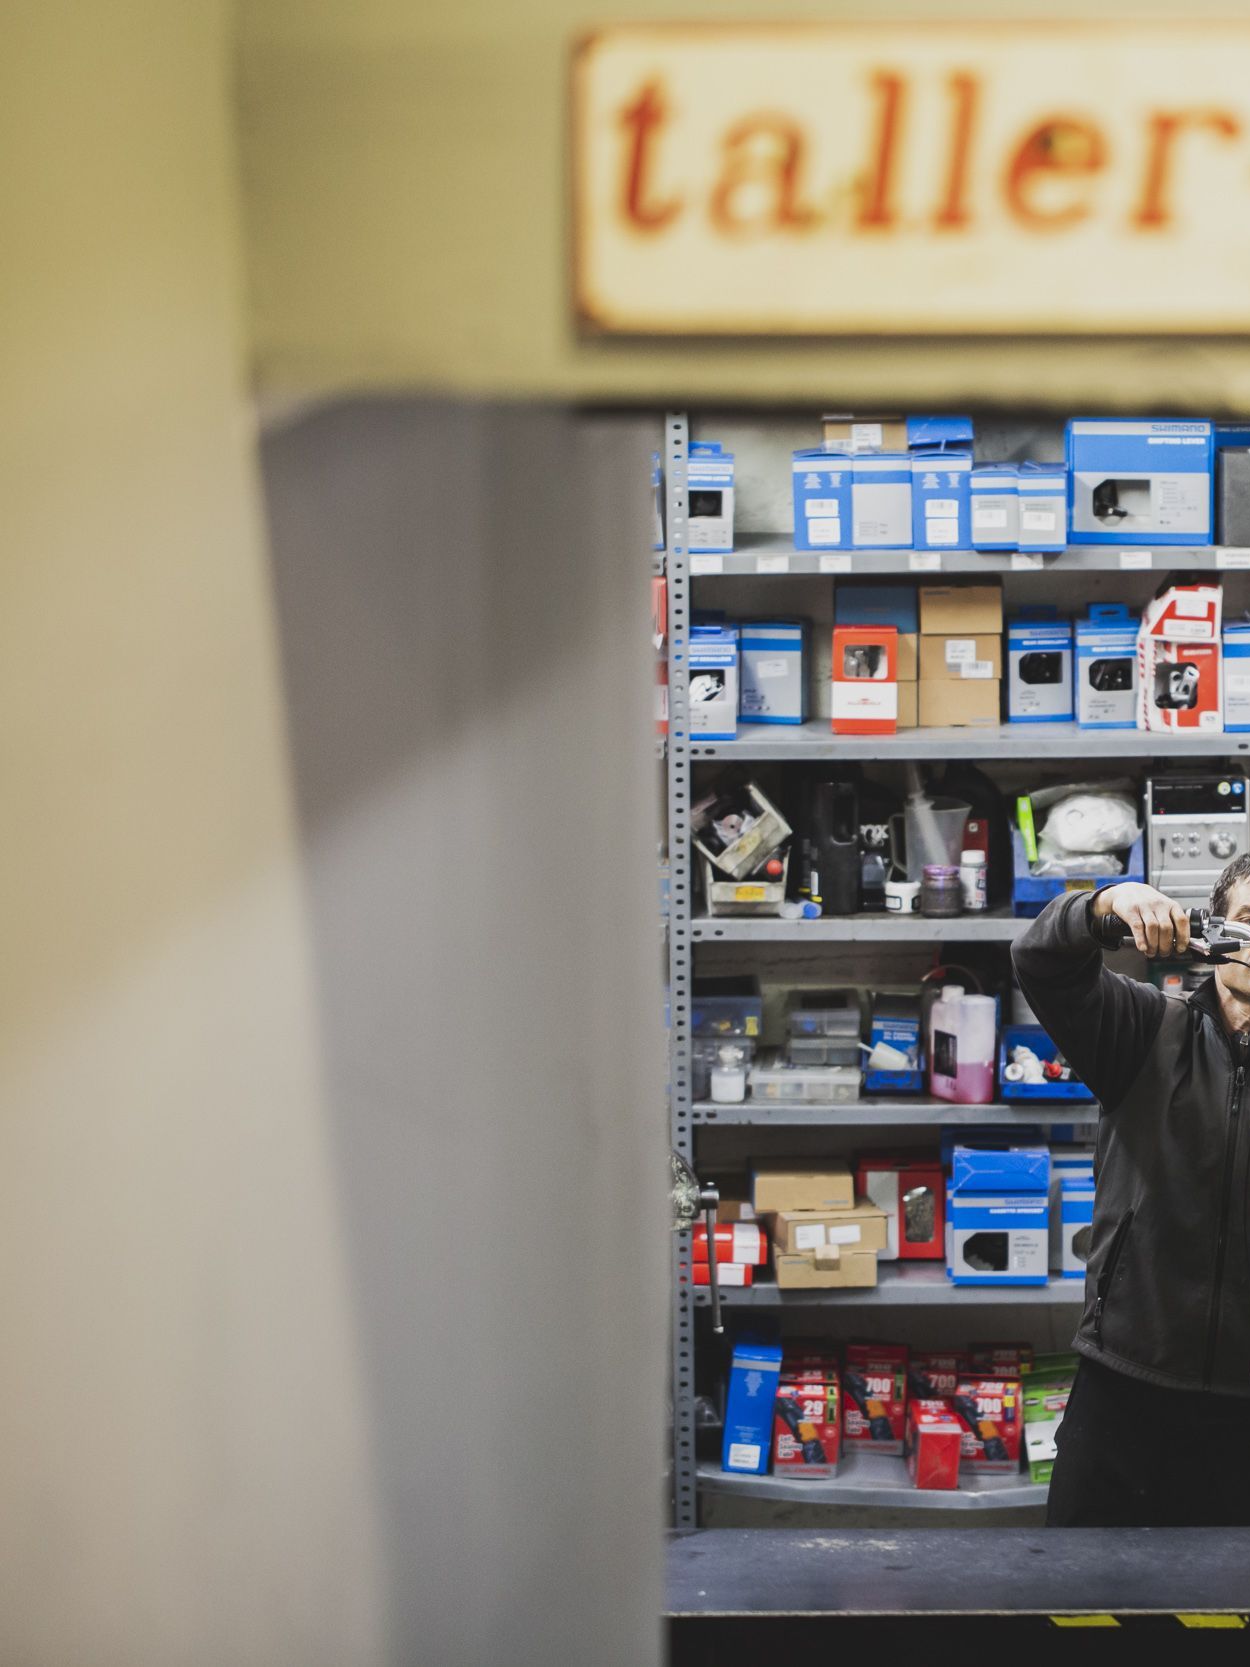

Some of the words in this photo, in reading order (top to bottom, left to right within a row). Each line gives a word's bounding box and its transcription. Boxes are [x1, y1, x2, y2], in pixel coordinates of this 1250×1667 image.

[1151, 424, 1206, 433] SHIMANO
[865, 1377, 892, 1394] 700
[928, 1374, 956, 1389] 700
[976, 1397, 1002, 1414] 700
